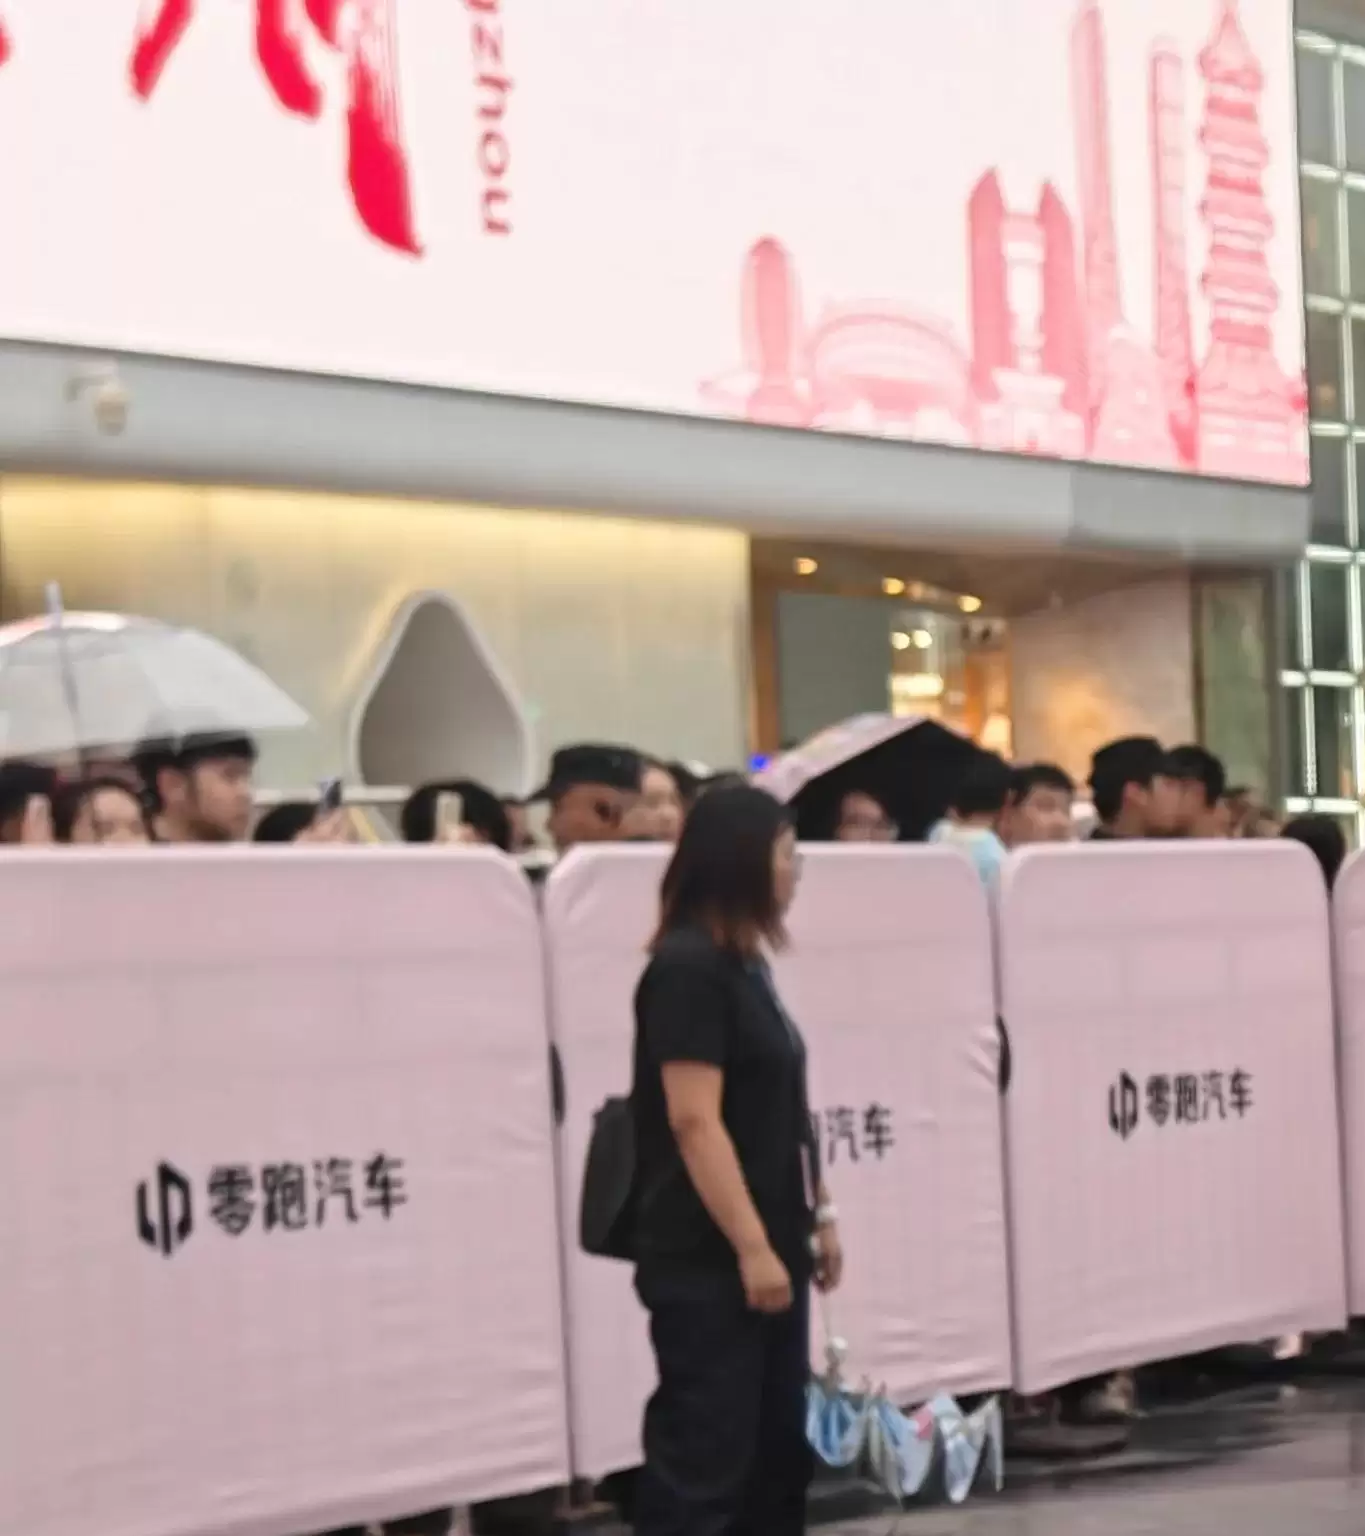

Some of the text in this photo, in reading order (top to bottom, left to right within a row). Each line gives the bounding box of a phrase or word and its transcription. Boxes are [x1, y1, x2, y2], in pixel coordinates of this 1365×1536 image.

[465, 0, 513, 234] zhou
[1145, 1068, 1254, 1127] 零跑汽车
[812, 1103, 896, 1166] 汽车
[207, 1153, 408, 1236] 零跑汽车
